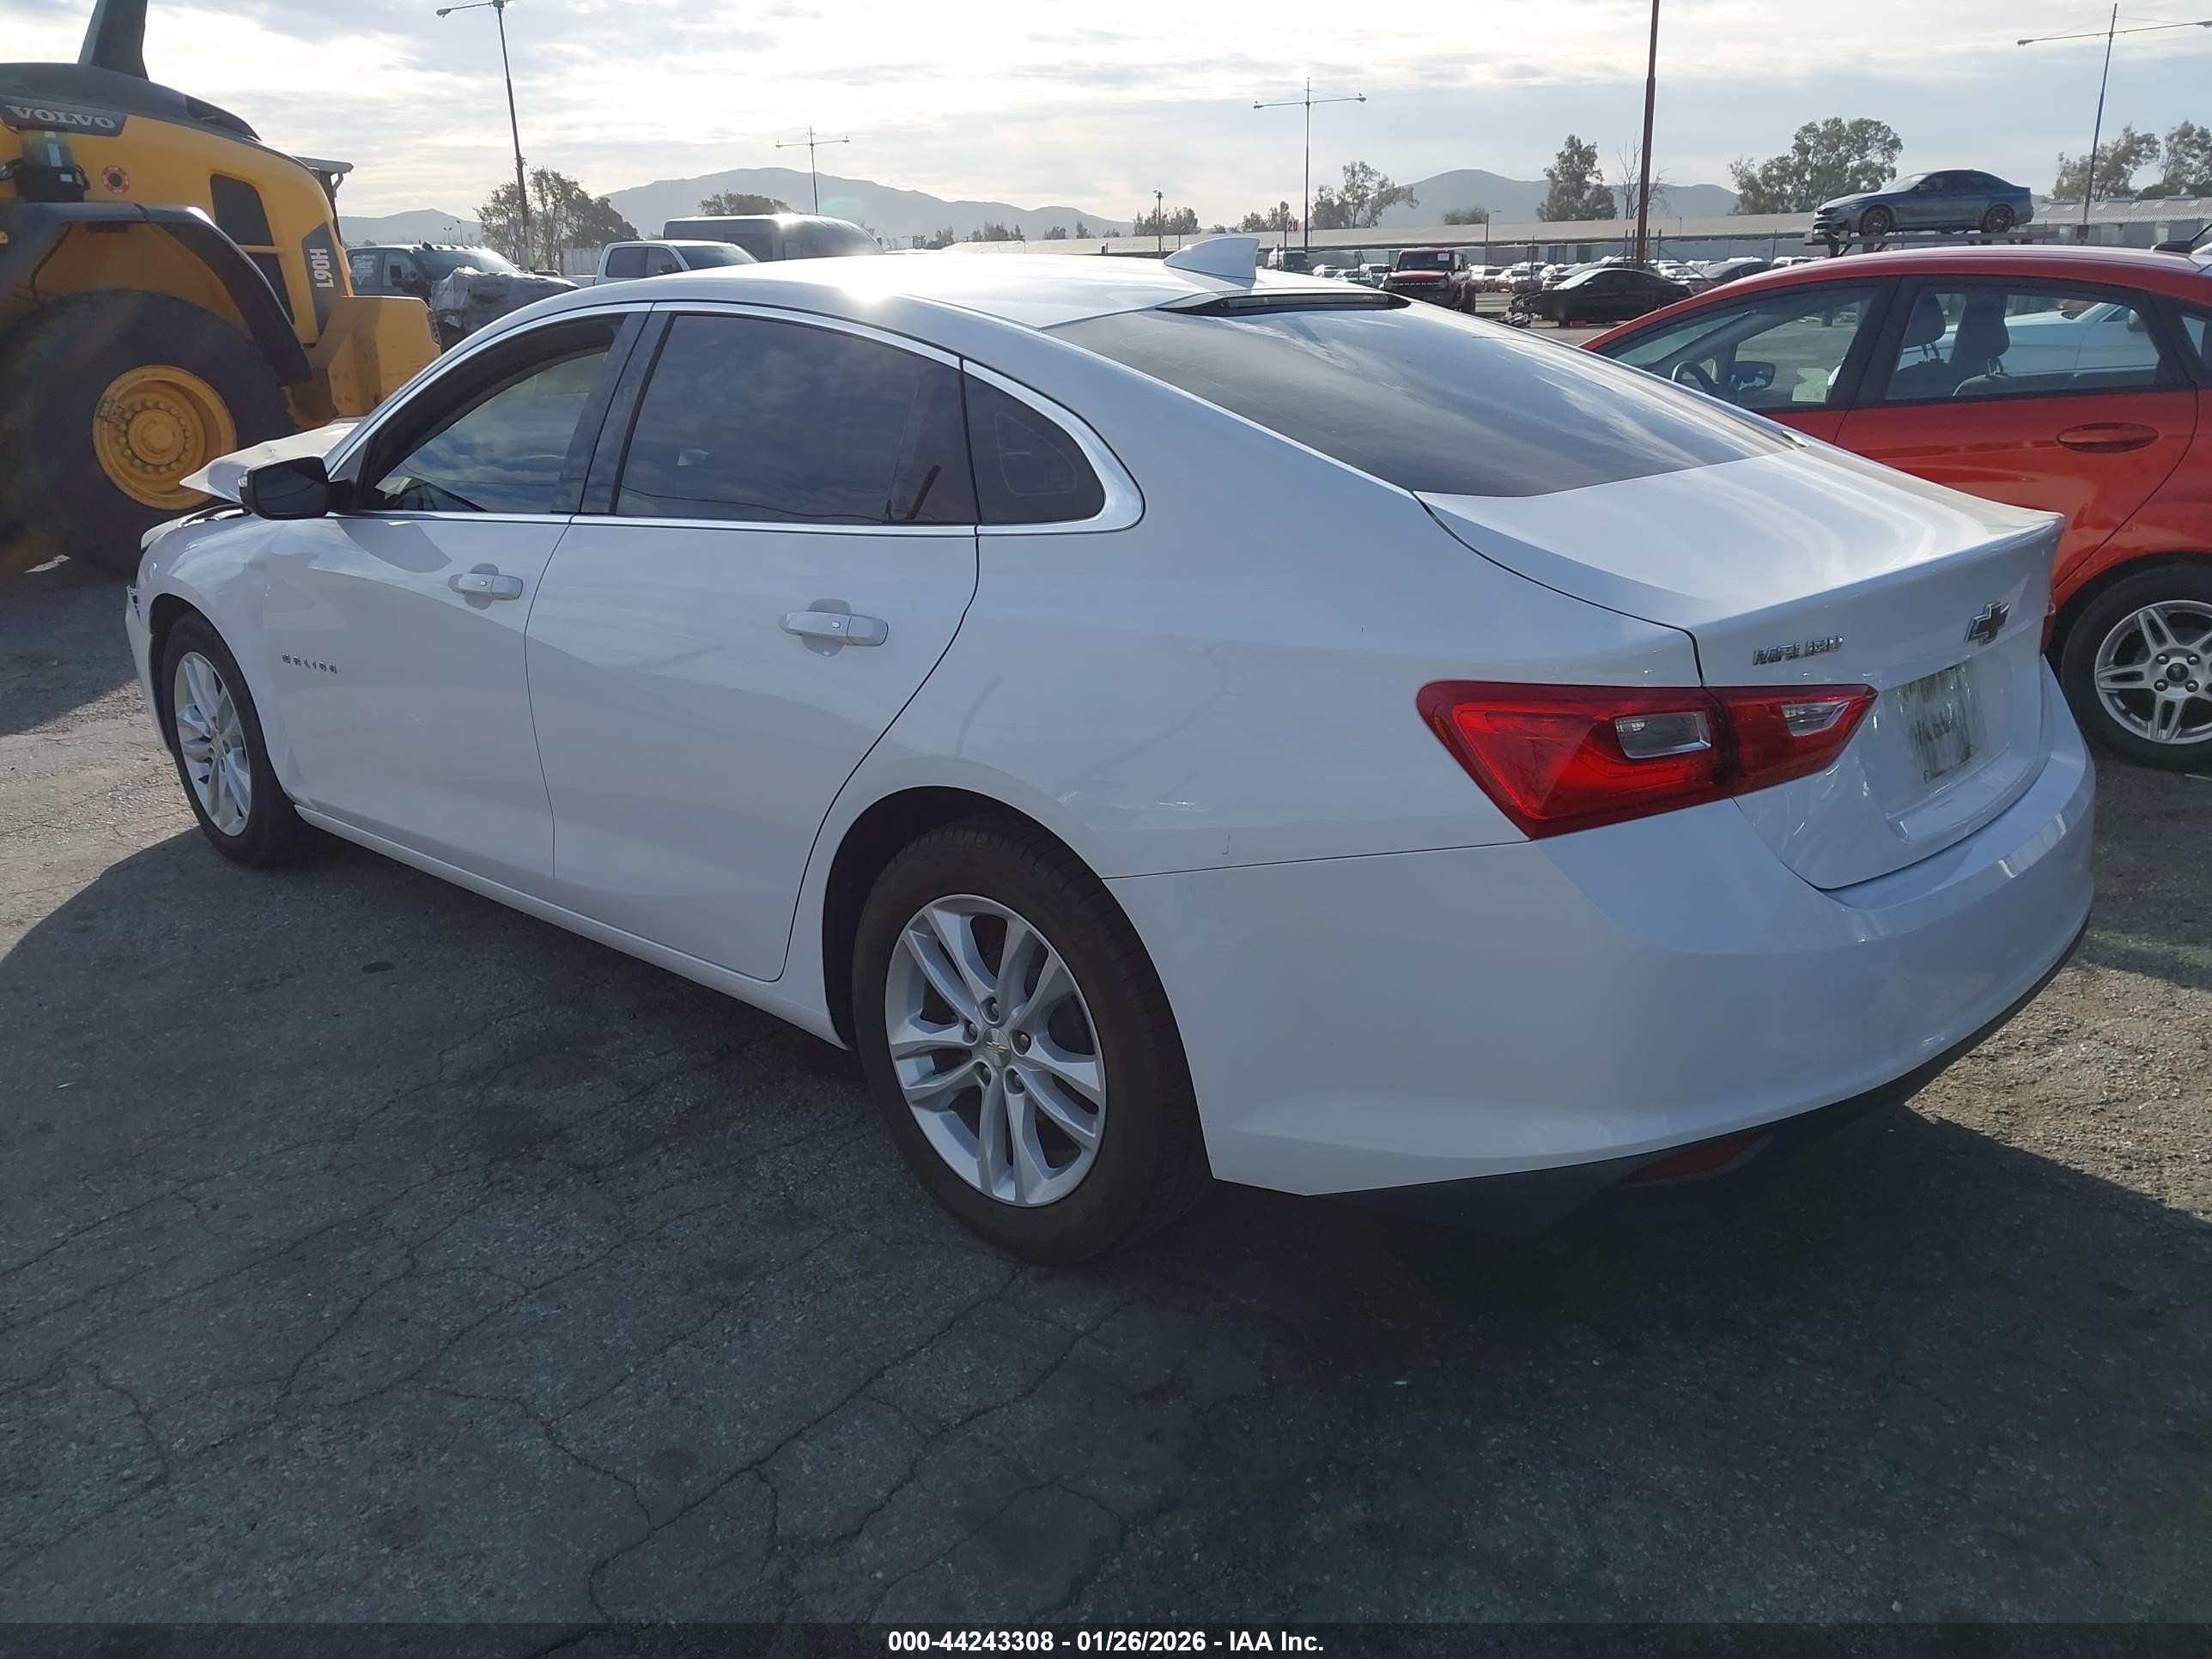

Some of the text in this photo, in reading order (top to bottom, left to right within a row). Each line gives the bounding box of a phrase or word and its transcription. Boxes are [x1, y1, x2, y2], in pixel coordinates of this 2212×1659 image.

[4, 104, 116, 129] VOLVO
[1288, 221, 1297, 232] 20
[309, 247, 334, 289] L90H
[1752, 635, 1844, 666] MALIBU
